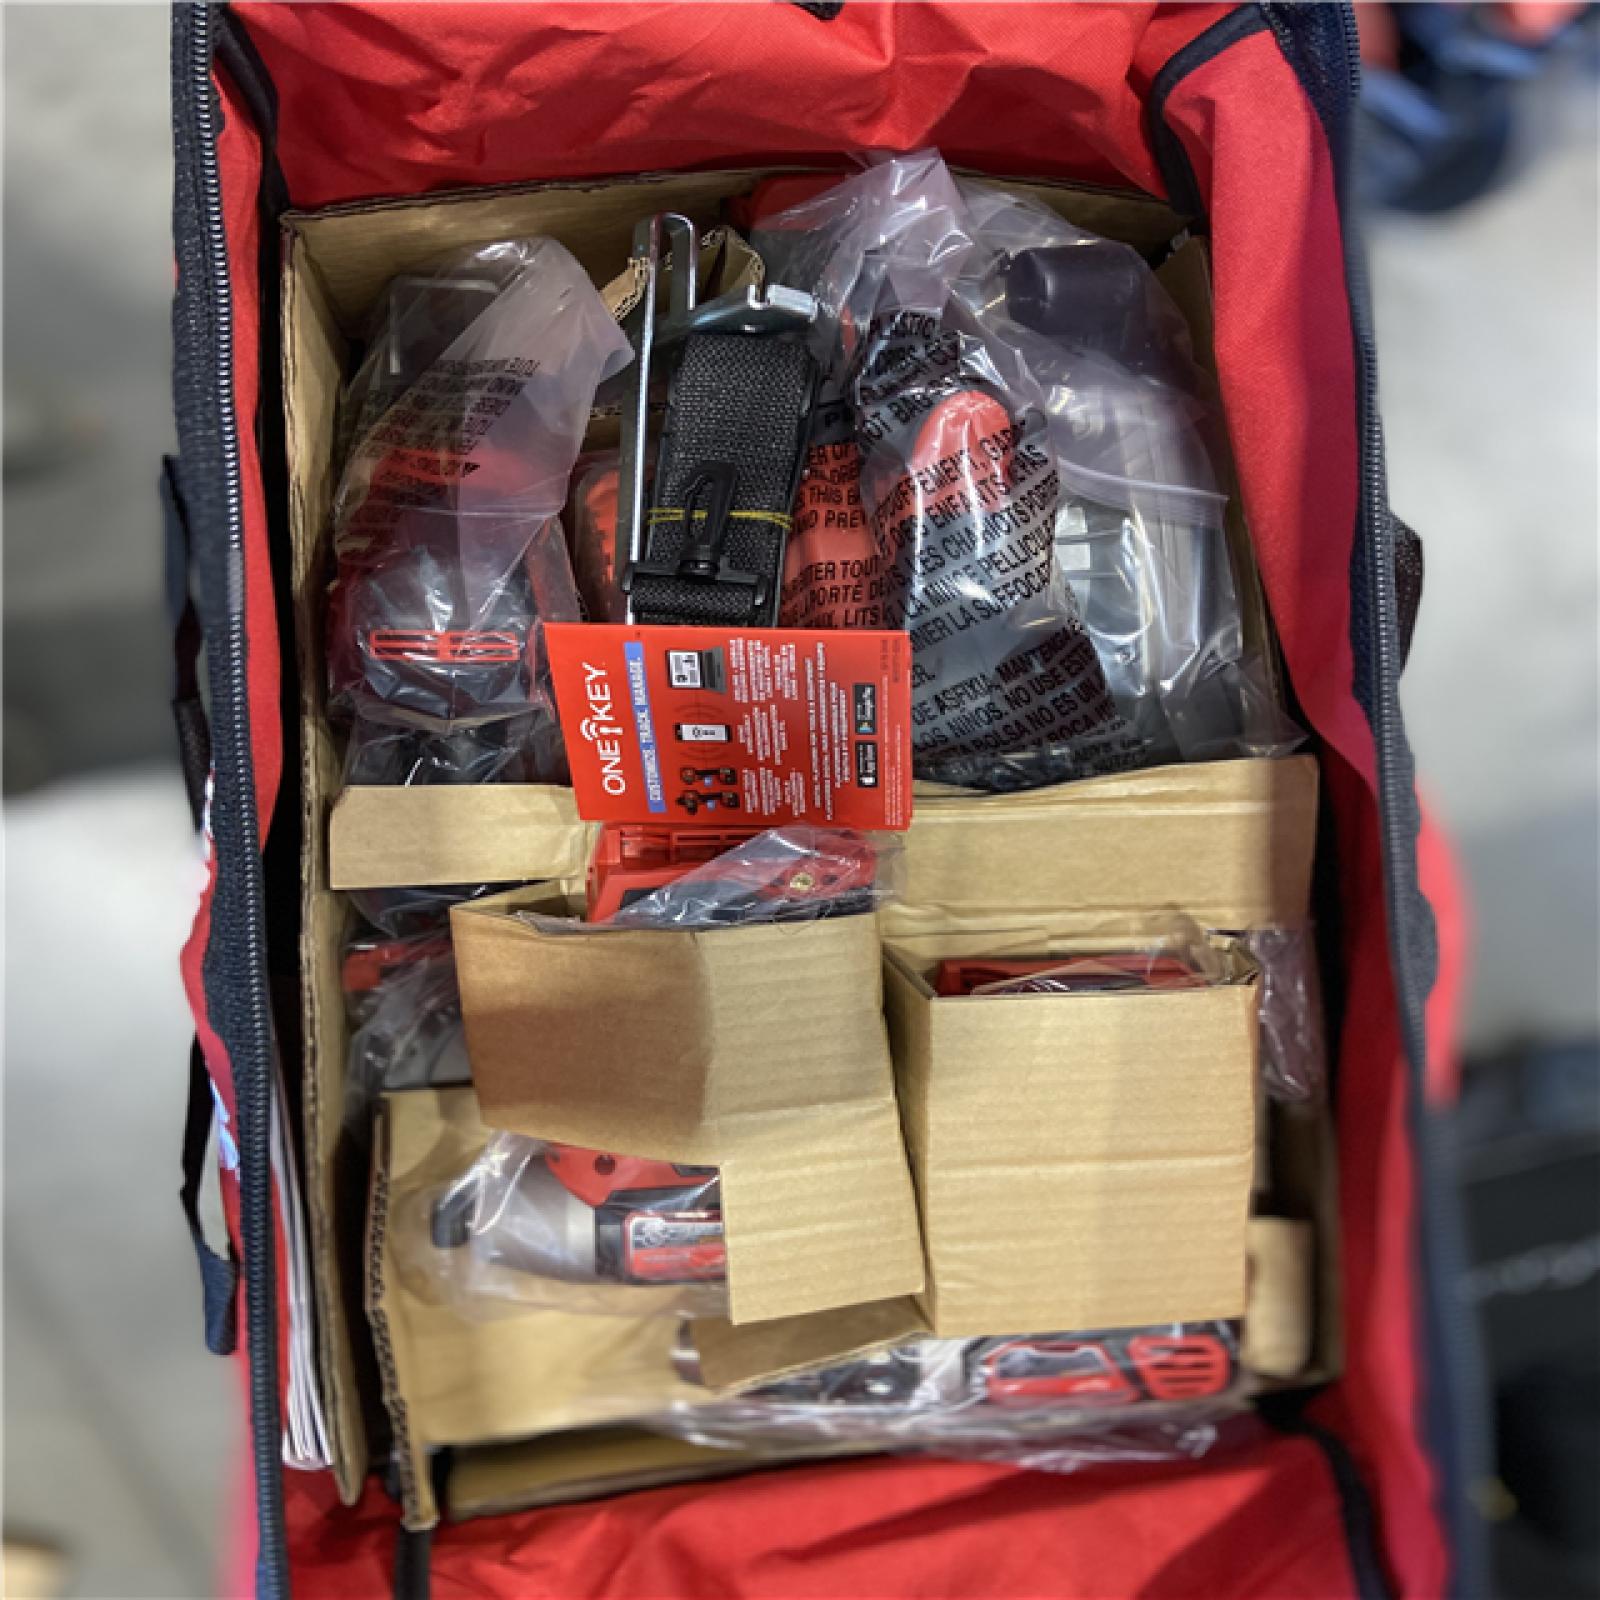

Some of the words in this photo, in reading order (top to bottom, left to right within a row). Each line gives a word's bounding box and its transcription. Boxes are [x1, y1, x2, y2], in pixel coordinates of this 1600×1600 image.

[951, 602, 982, 633] LA
[582, 662, 616, 722] KEY
[1003, 683, 1033, 712] NO
[1031, 664, 1070, 697] USE
[1025, 700, 1058, 735] NO
[1050, 690, 1080, 721] ES
[596, 740, 627, 797] ONE
